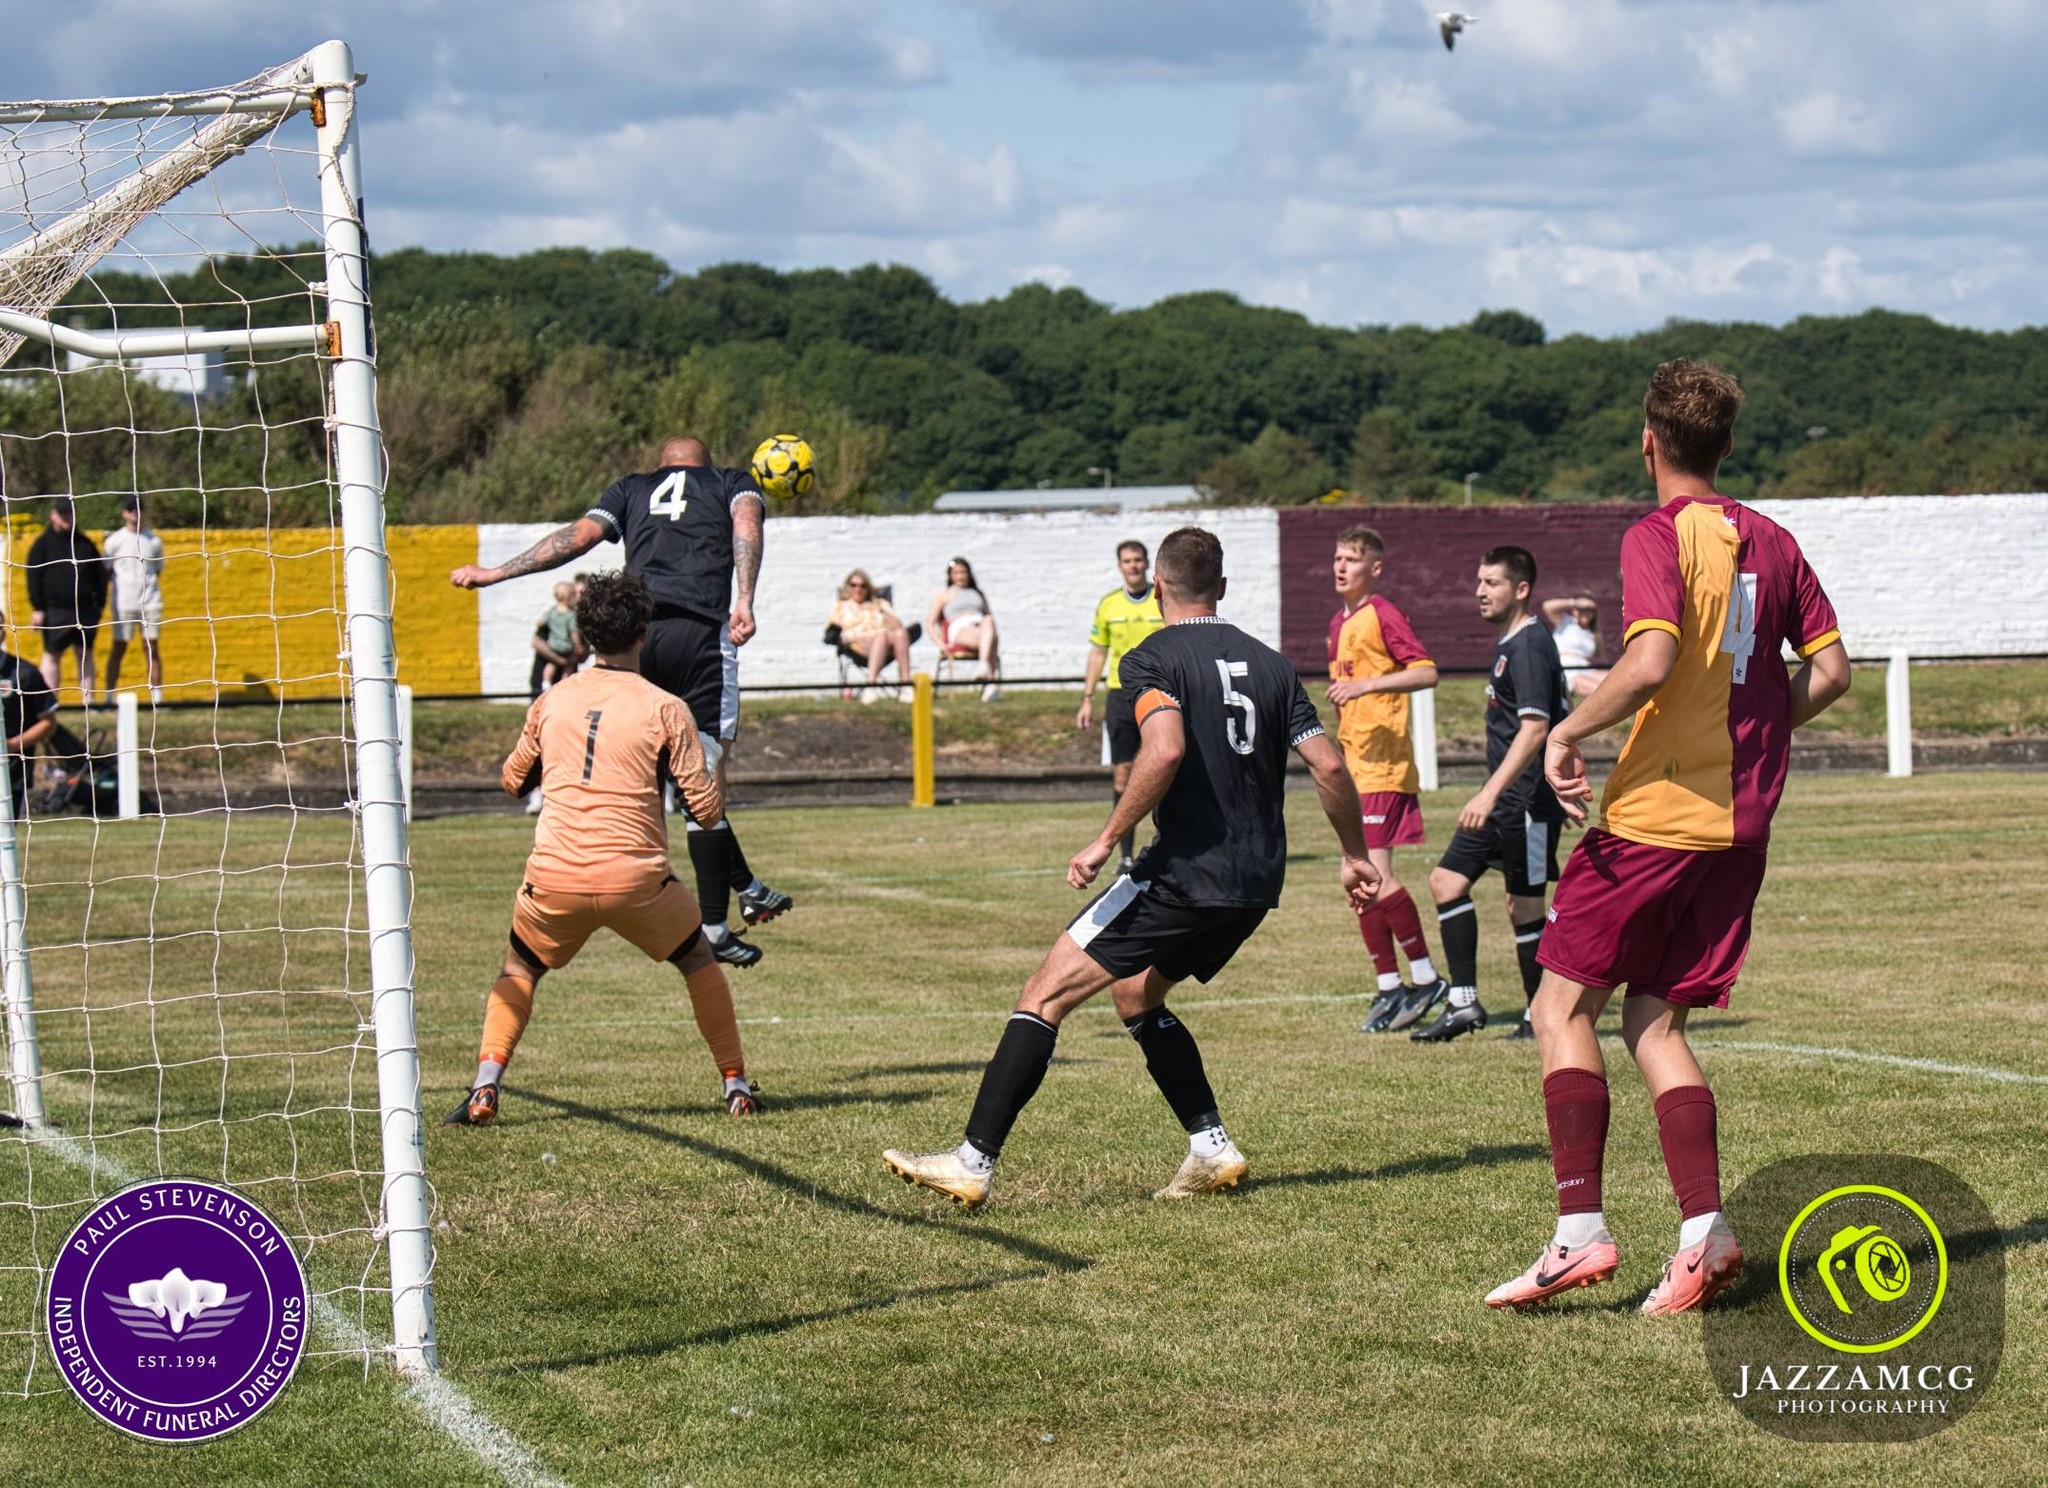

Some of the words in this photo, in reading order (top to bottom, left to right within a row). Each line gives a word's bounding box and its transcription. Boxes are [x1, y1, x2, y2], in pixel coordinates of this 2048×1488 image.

[649, 470, 688, 521] 4
[1720, 573, 1757, 684] 4
[581, 710, 602, 785] 1
[1215, 659, 1256, 755] 5
